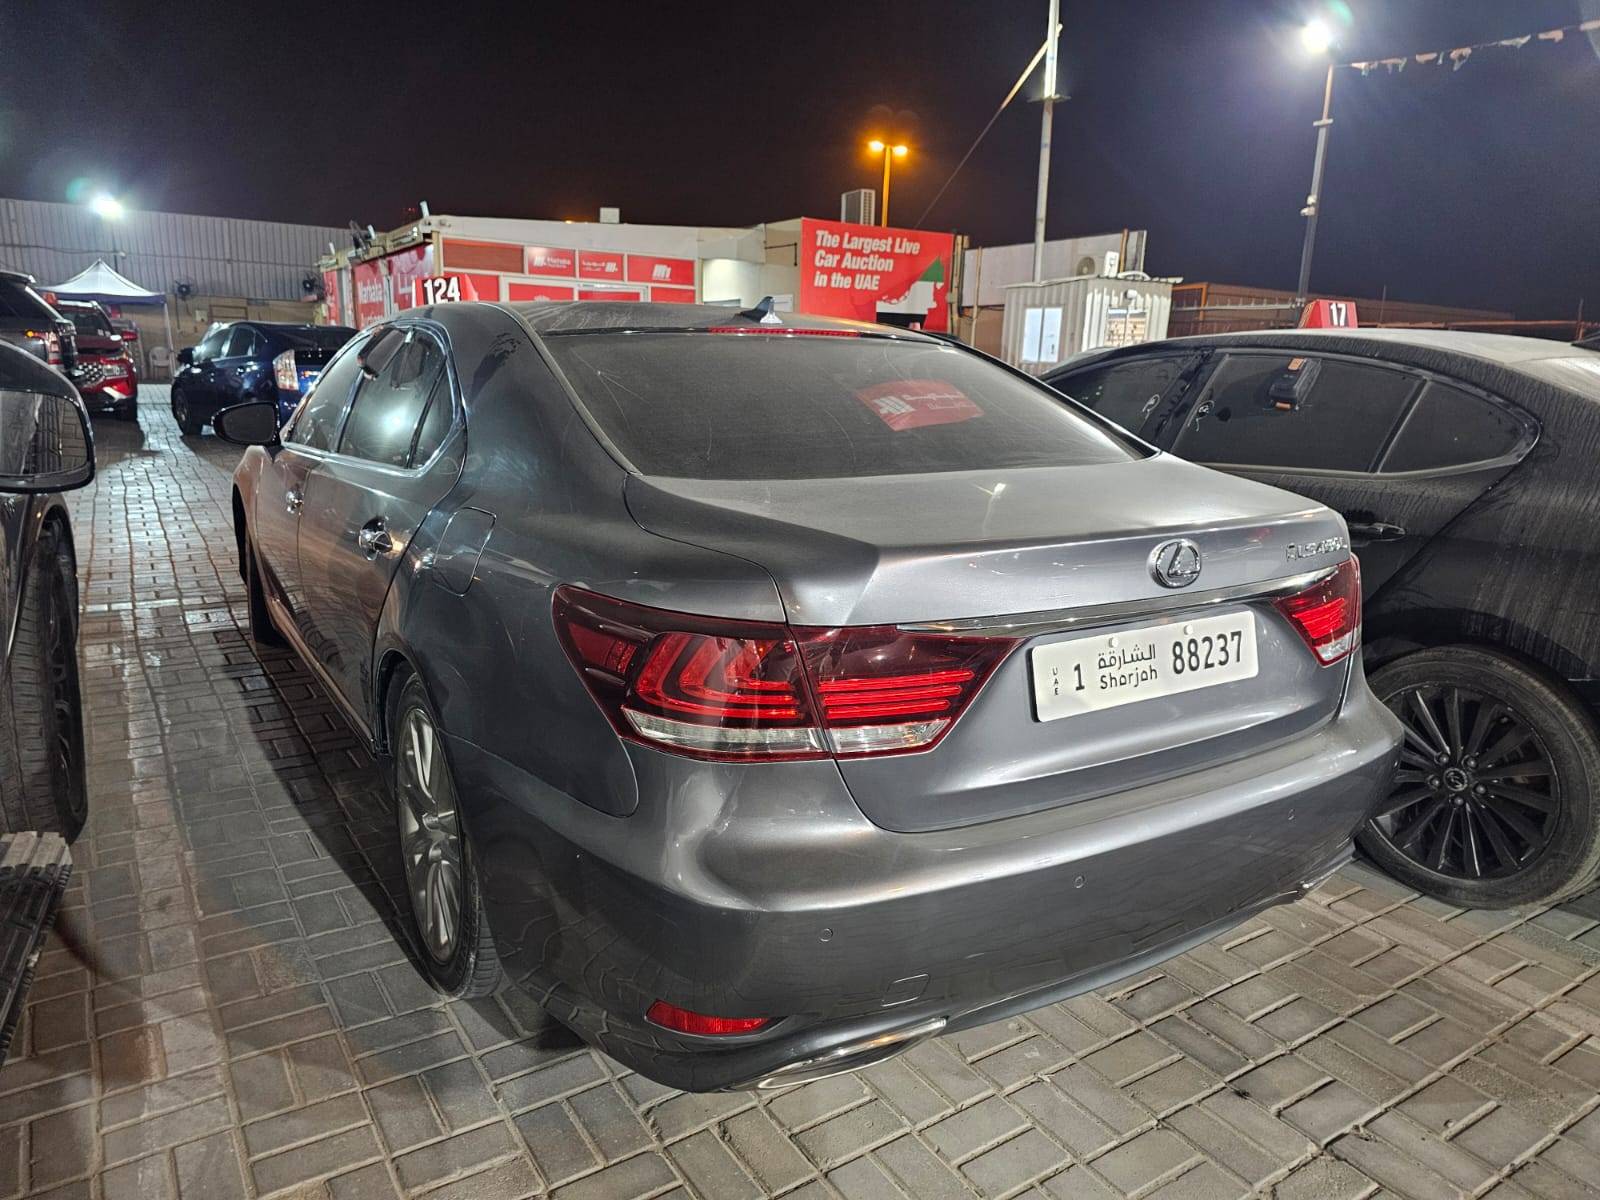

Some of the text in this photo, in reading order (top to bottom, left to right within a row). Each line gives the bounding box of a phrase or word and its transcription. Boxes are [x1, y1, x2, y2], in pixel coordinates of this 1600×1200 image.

[815, 229, 920, 255] The Largest Live
[814, 249, 894, 272] Car Auction
[424, 277, 460, 305] 124
[814, 271, 880, 290] in the UAE
[1330, 302, 1346, 326] 17
[1098, 644, 1156, 671] الشارقة
[1172, 630, 1242, 675] 88237
[1074, 663, 1085, 691] 1
[1100, 665, 1157, 689] Sharjah
